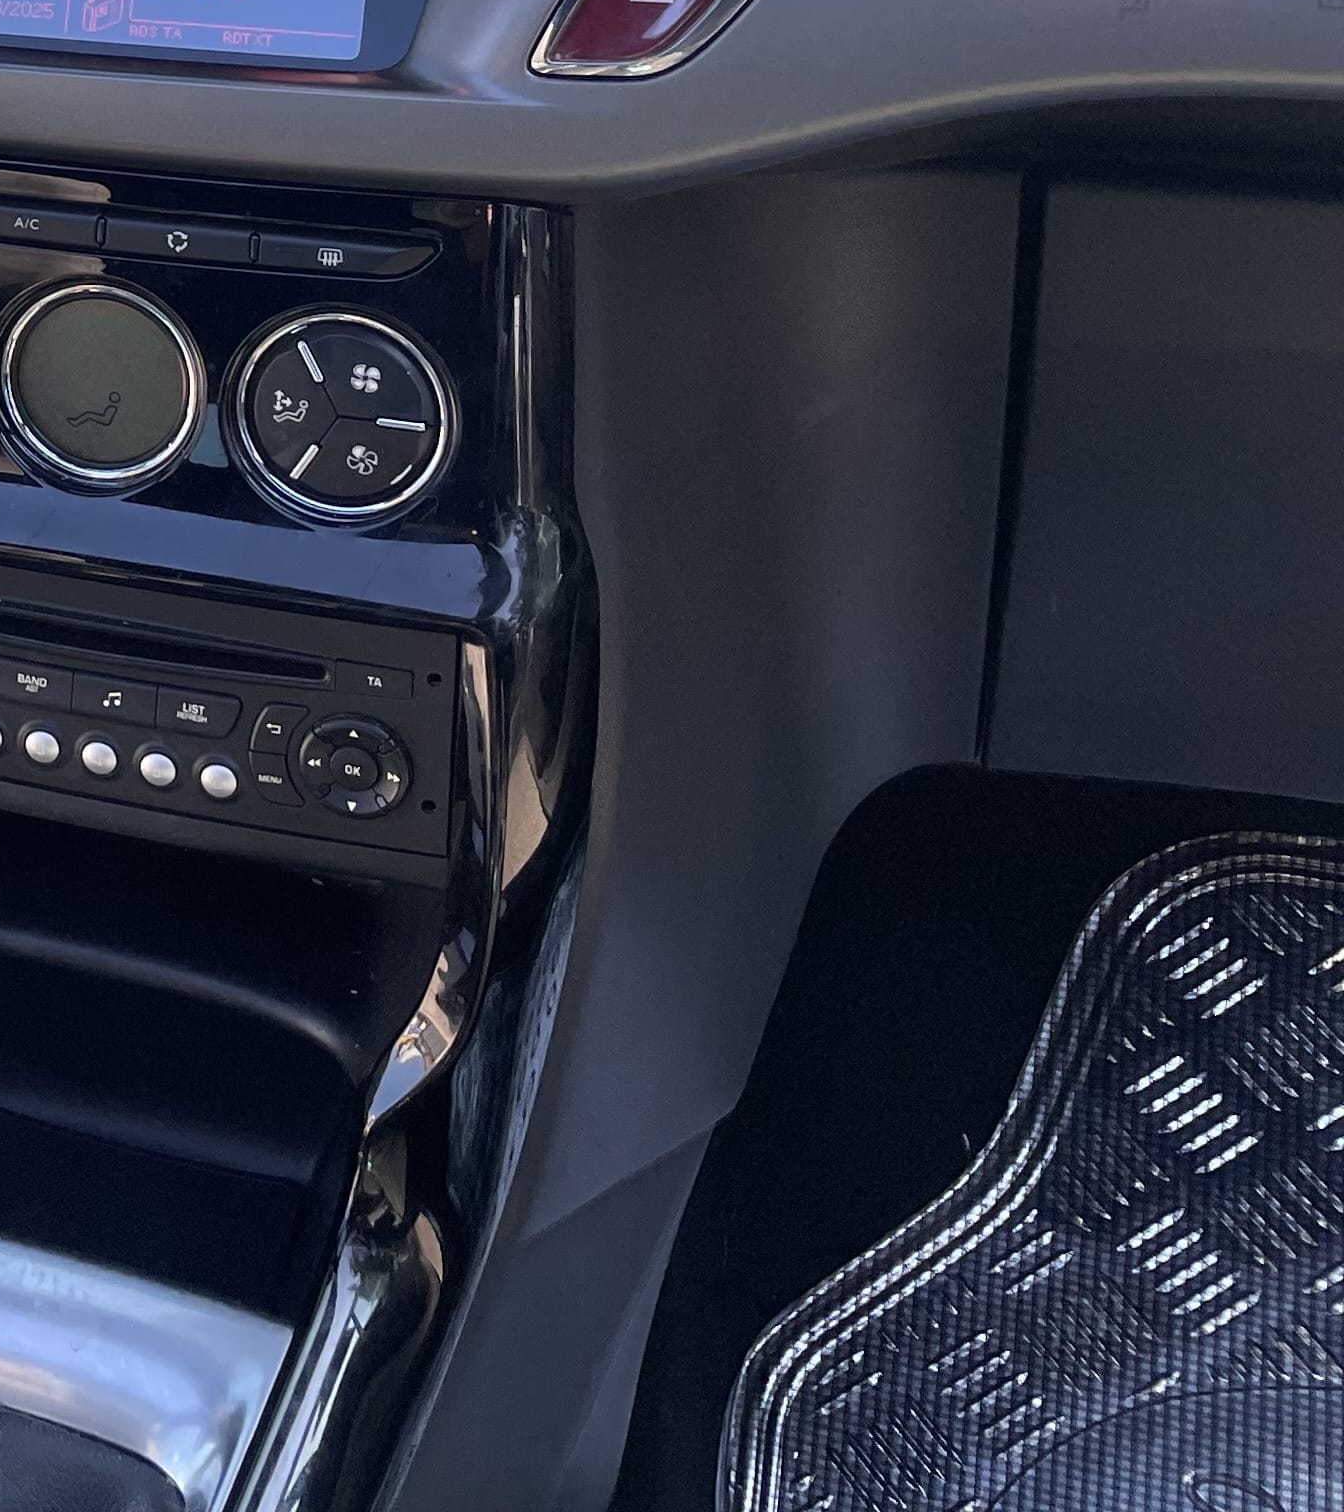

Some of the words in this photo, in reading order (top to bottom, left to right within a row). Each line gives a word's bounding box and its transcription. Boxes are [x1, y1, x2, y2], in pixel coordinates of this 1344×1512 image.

[129, 25, 158, 38] RDS
[162, 26, 183, 39] TA
[14, 217, 40, 230] A/C
[17, 672, 48, 688] BAND
[367, 675, 383, 688] TA
[182, 702, 206, 716] LIST
[344, 763, 361, 777] OK
[258, 774, 283, 785] MENU
